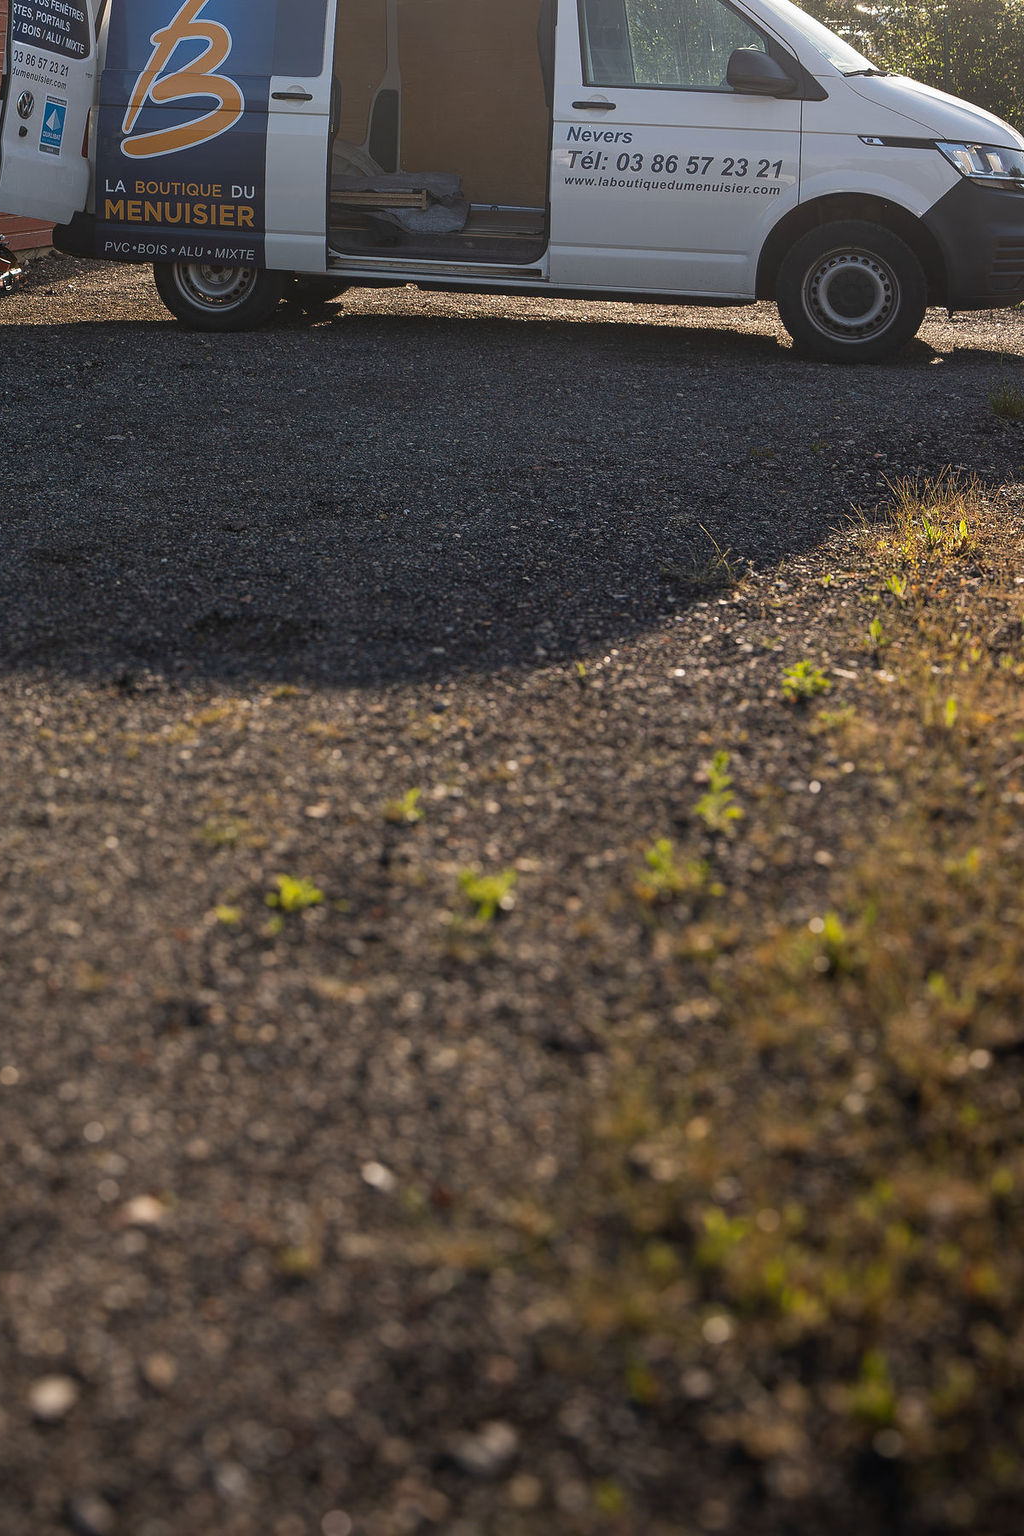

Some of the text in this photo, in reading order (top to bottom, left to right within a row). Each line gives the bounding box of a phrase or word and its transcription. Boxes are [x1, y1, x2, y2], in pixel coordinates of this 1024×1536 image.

[36, 10, 71, 32] PORTAILS
[50, 0, 84, 22] FENÊTRES
[21, 23, 41, 38] BOIS
[46, 31, 61, 45] ALU
[66, 38, 85, 54] MIXTE
[25, 53, 36, 67] 86
[37, 57, 48, 70] 57
[49, 60, 59, 74] 23
[60, 64, 69, 77] 21
[566, 126, 633, 144] Nevers
[567, 150, 784, 179] Tél: 03 86 57 23 21
[105, 179, 255, 199] LA BOUTIQUE DU
[564, 176, 781, 196] www.laboutiquedumenuisier.com
[105, 199, 255, 228] MENUISIER
[104, 241, 255, 261] PVC BOIS ALU MIXTE
